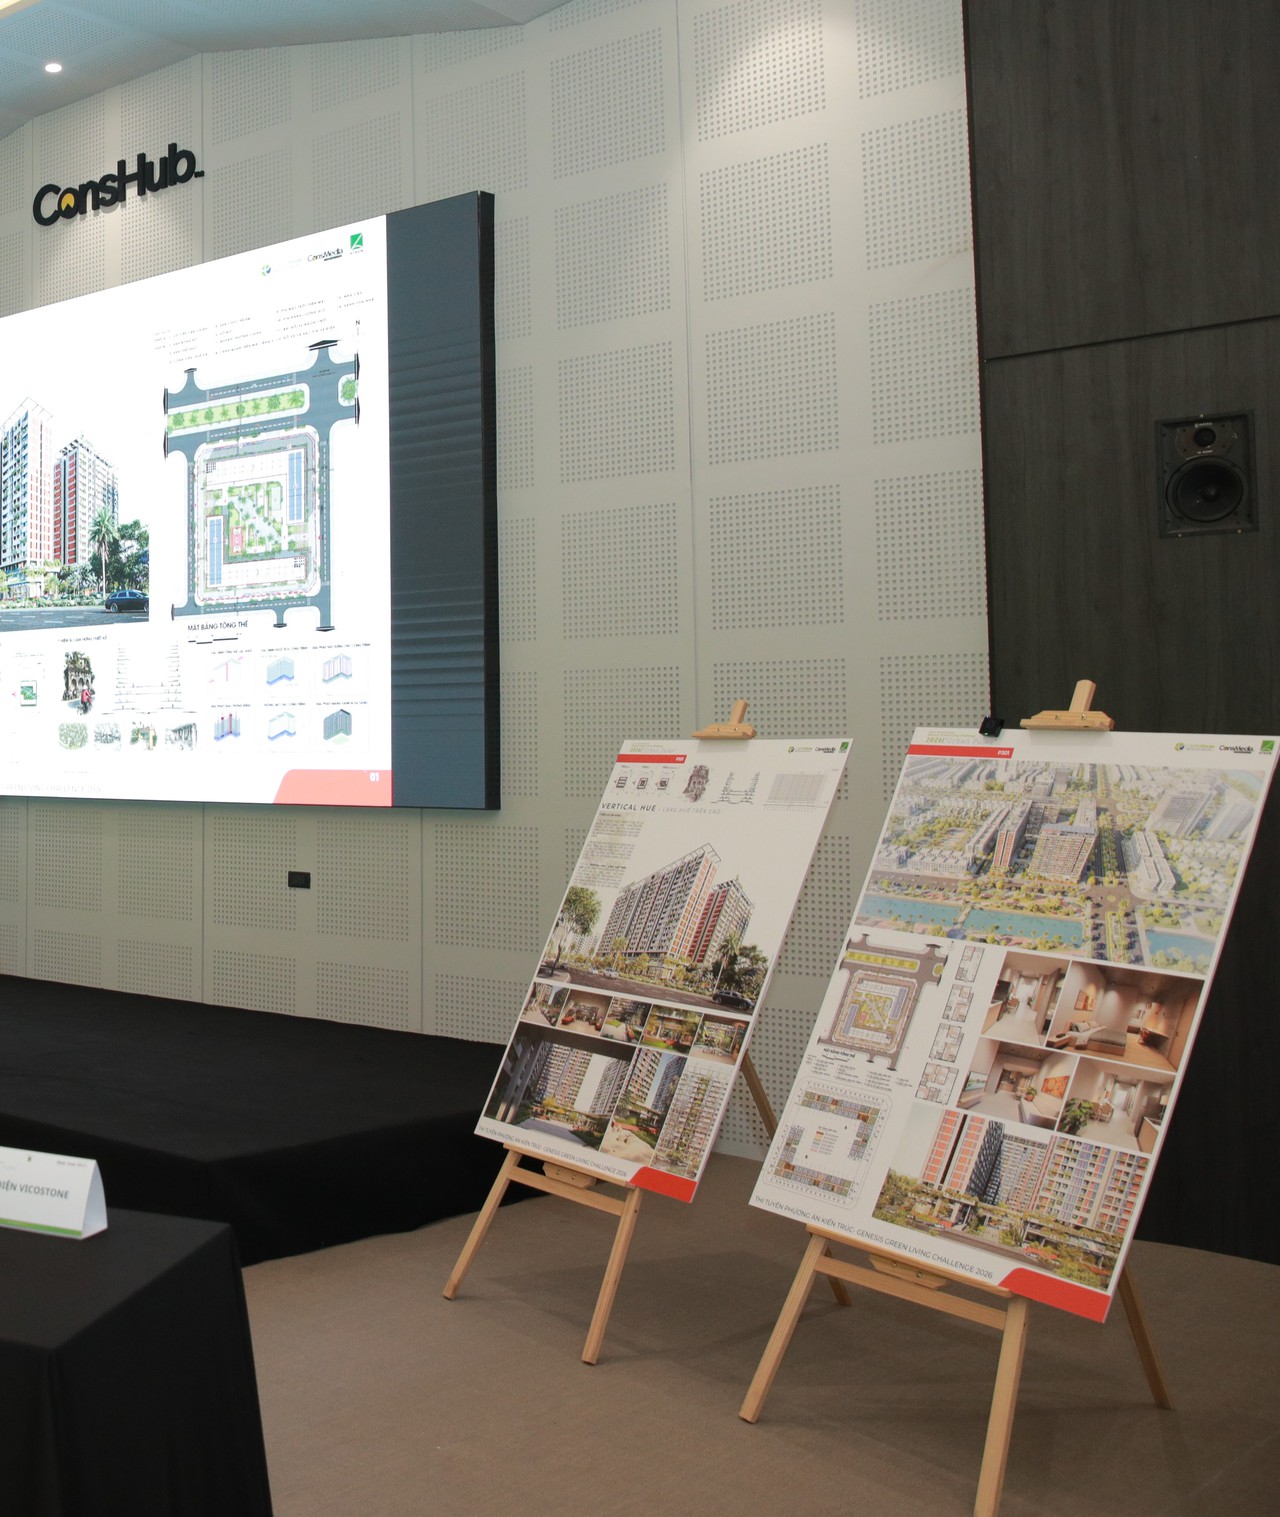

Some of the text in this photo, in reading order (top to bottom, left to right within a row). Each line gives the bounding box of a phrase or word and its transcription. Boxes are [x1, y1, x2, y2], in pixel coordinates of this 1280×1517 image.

[601, 803, 637, 811] VERTICAL
[640, 804, 657, 812] HUE
[19, 1184, 69, 1199] VICOSTONE
[856, 1228, 884, 1243] GENESIS
[884, 1238, 908, 1250] GREEN
[908, 1246, 932, 1259] LIVING
[932, 1253, 976, 1273] CHALLENGE
[976, 1267, 993, 1279] 2026
